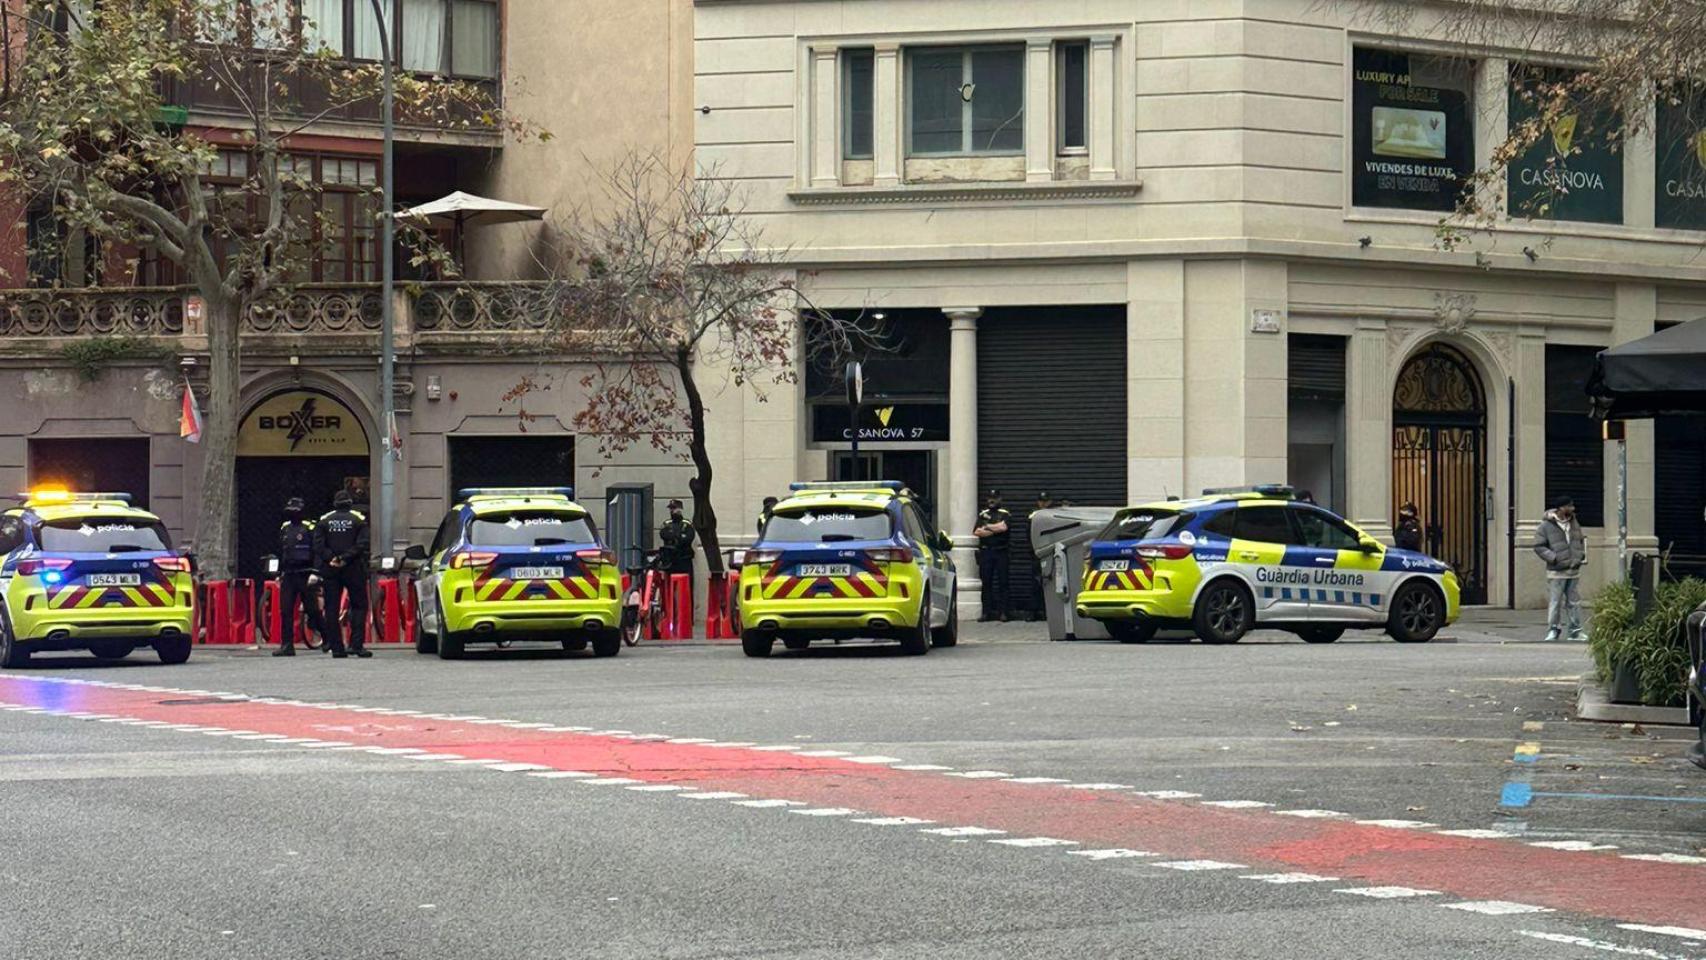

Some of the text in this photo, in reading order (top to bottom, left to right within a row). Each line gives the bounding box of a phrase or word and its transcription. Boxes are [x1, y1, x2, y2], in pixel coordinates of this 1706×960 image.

[1356, 70, 1394, 84] LUXURY
[1365, 161, 1414, 176] VIVENDES
[1414, 164, 1428, 176] DE
[1520, 167, 1605, 191] CASANOVA
[259, 409, 341, 437] BOXER
[843, 427, 924, 439] CSANOVA 57
[1256, 566, 1365, 586] Guàrdia Urbana
